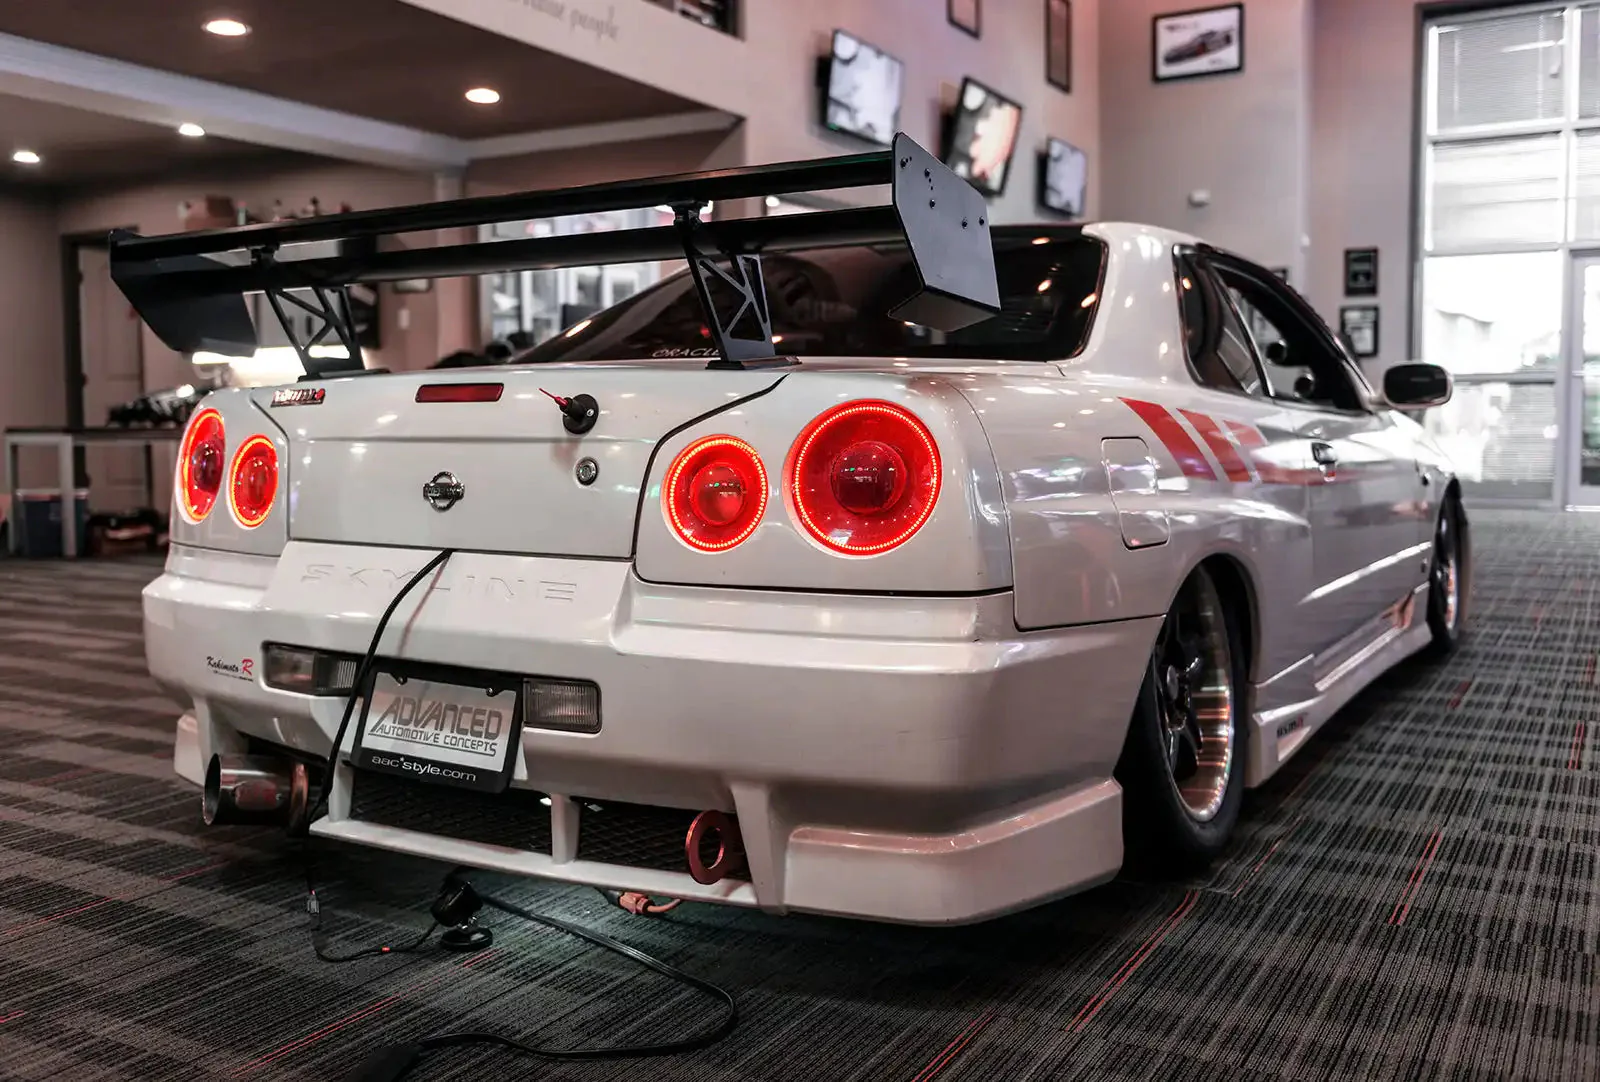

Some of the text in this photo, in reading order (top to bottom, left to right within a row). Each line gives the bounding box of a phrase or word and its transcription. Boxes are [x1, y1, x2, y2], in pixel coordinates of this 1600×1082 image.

[242, 658, 254, 677] R
[370, 697, 503, 741] ADVANCED
[376, 723, 498, 755] AUTOMOTIVE CONCEPTS
